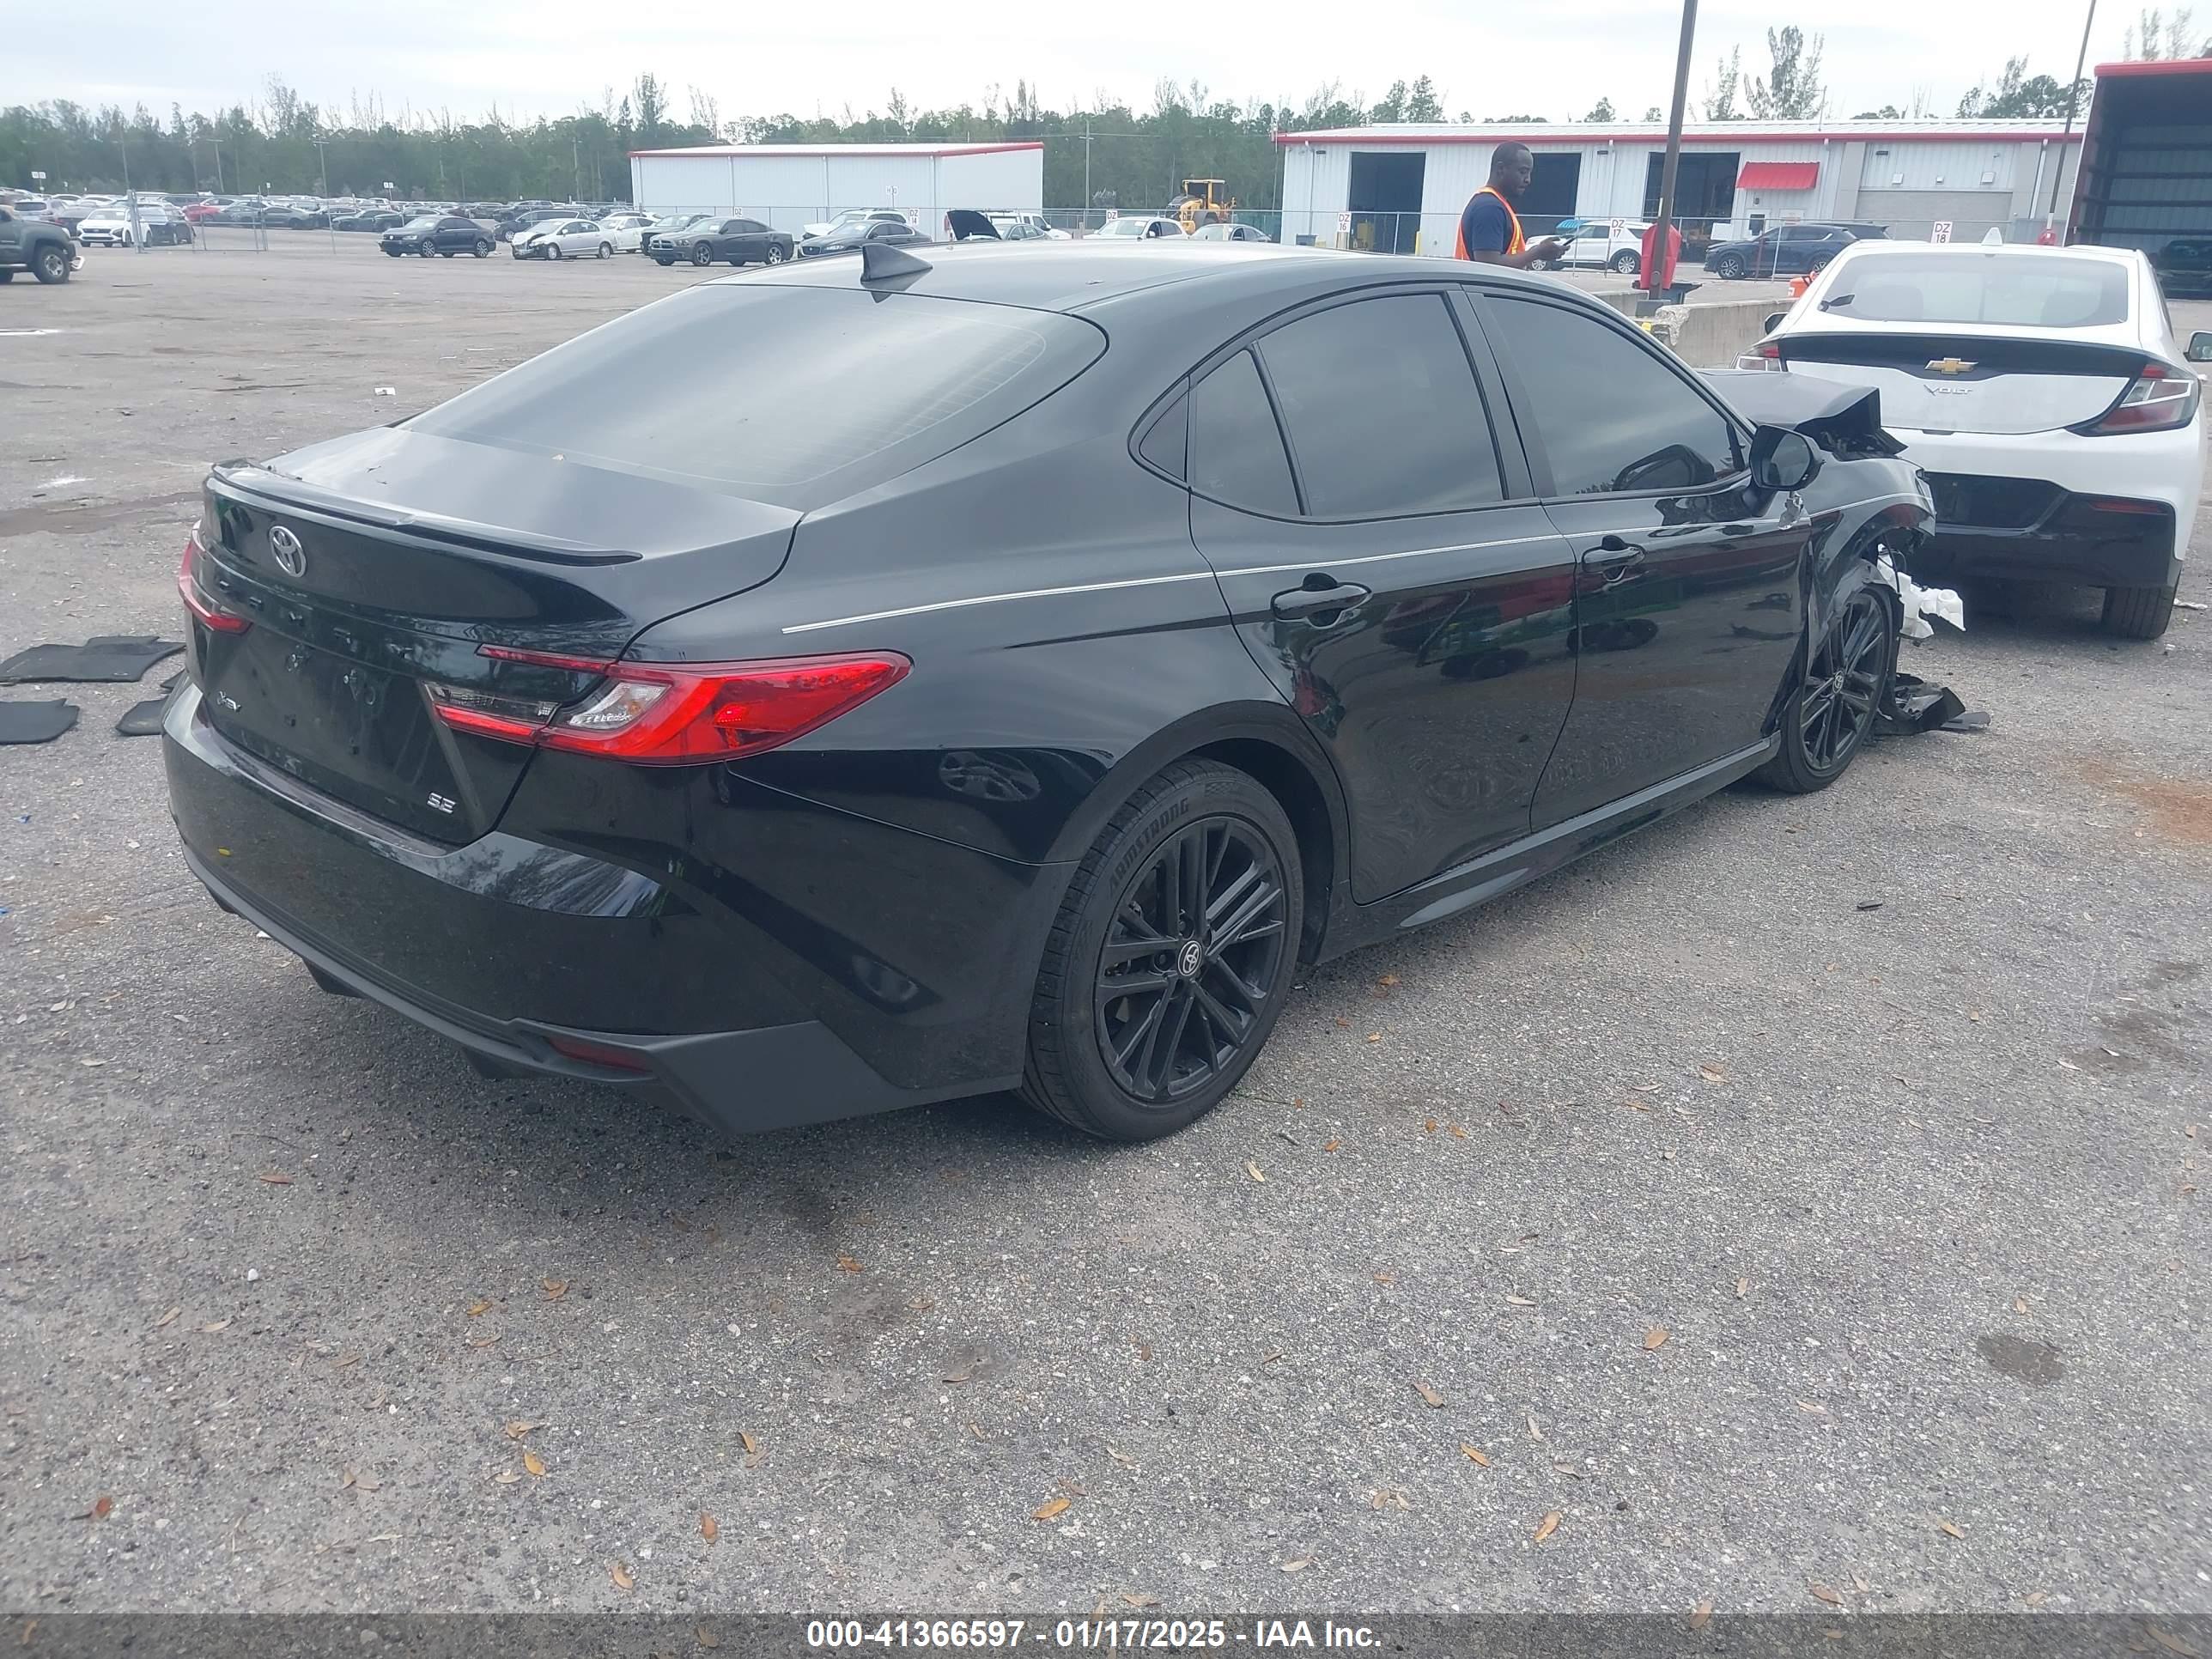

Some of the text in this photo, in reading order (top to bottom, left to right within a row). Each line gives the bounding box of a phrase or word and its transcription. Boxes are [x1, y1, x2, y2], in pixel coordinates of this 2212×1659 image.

[1340, 222, 1347, 231] 16
[1612, 219, 1625, 228] DZ
[1935, 223, 1951, 233] DZ
[1613, 228, 1621, 237] 17
[1936, 234, 1946, 243] 18
[1923, 384, 1973, 396] VOLT
[427, 792, 456, 814] SE
